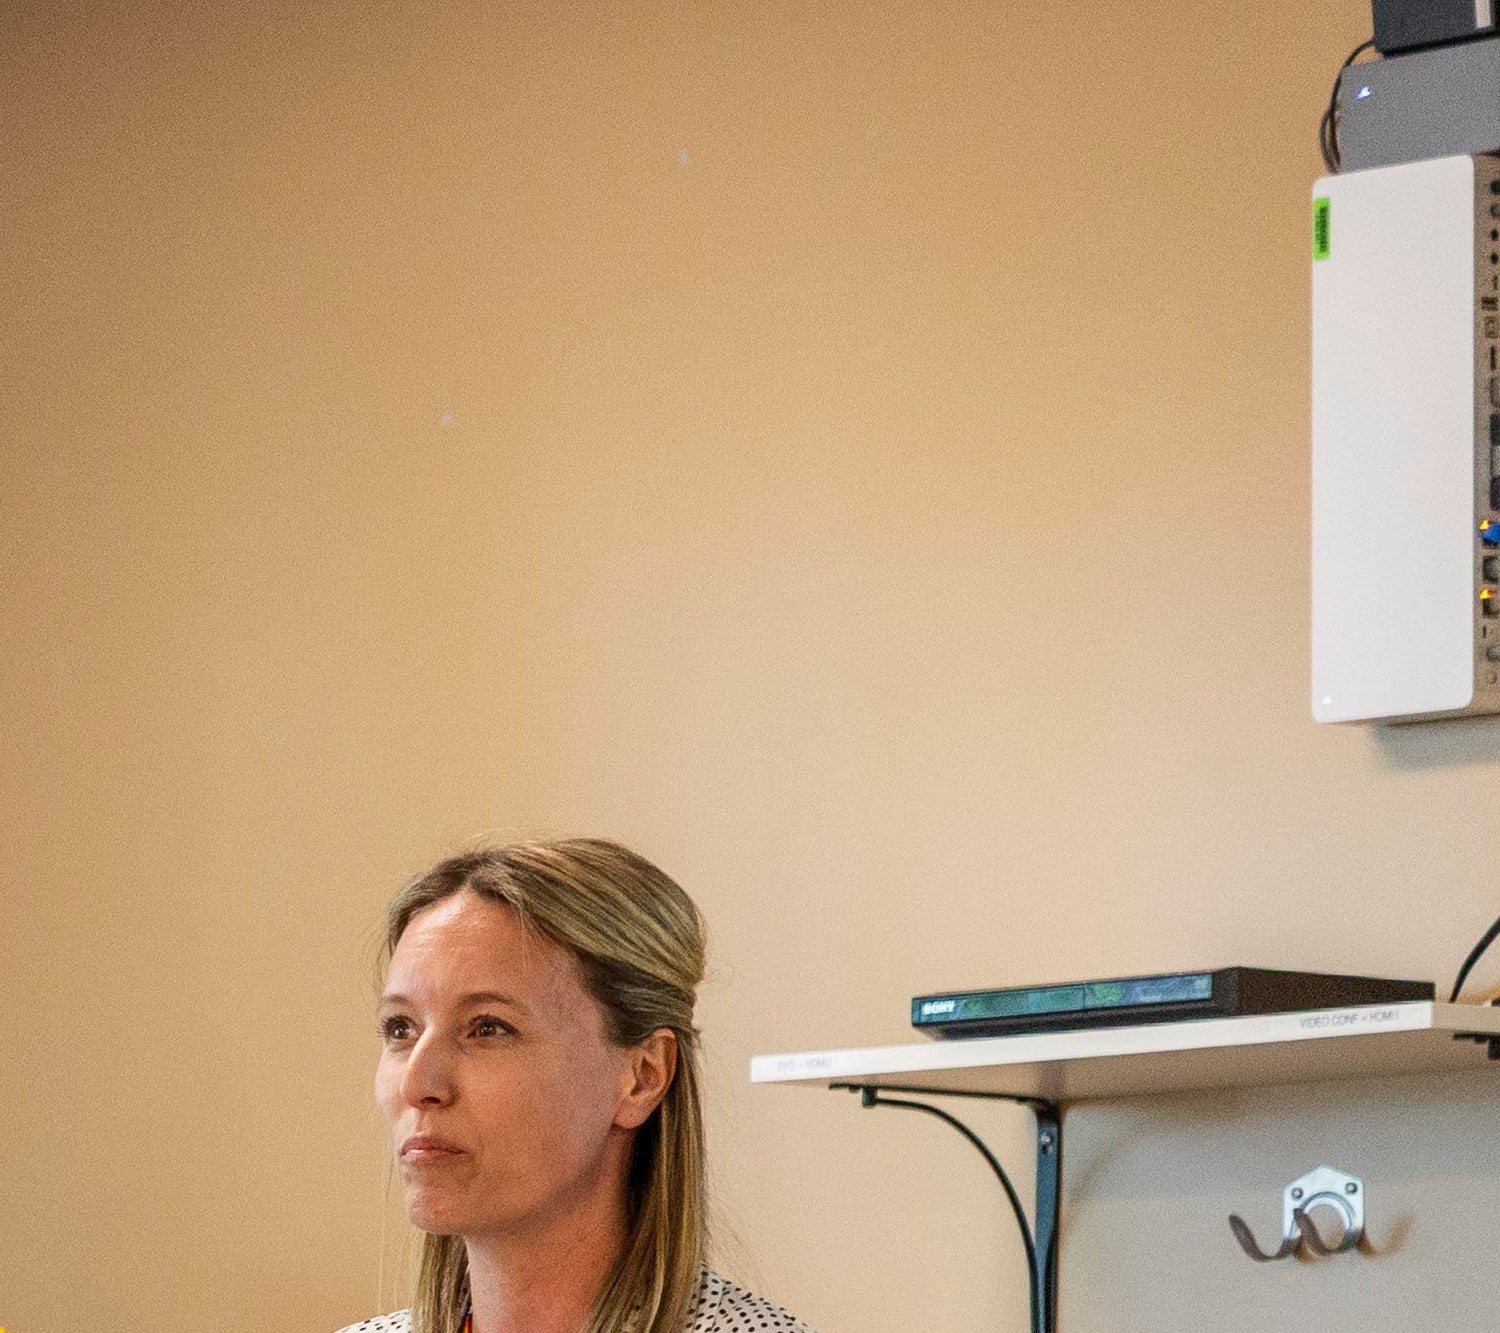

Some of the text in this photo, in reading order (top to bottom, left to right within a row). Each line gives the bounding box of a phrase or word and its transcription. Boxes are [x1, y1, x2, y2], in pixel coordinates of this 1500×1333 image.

[923, 1000, 955, 1014] SONY
[1300, 1014, 1329, 1029] VIDEO
[1332, 1013, 1358, 1026] CONF
